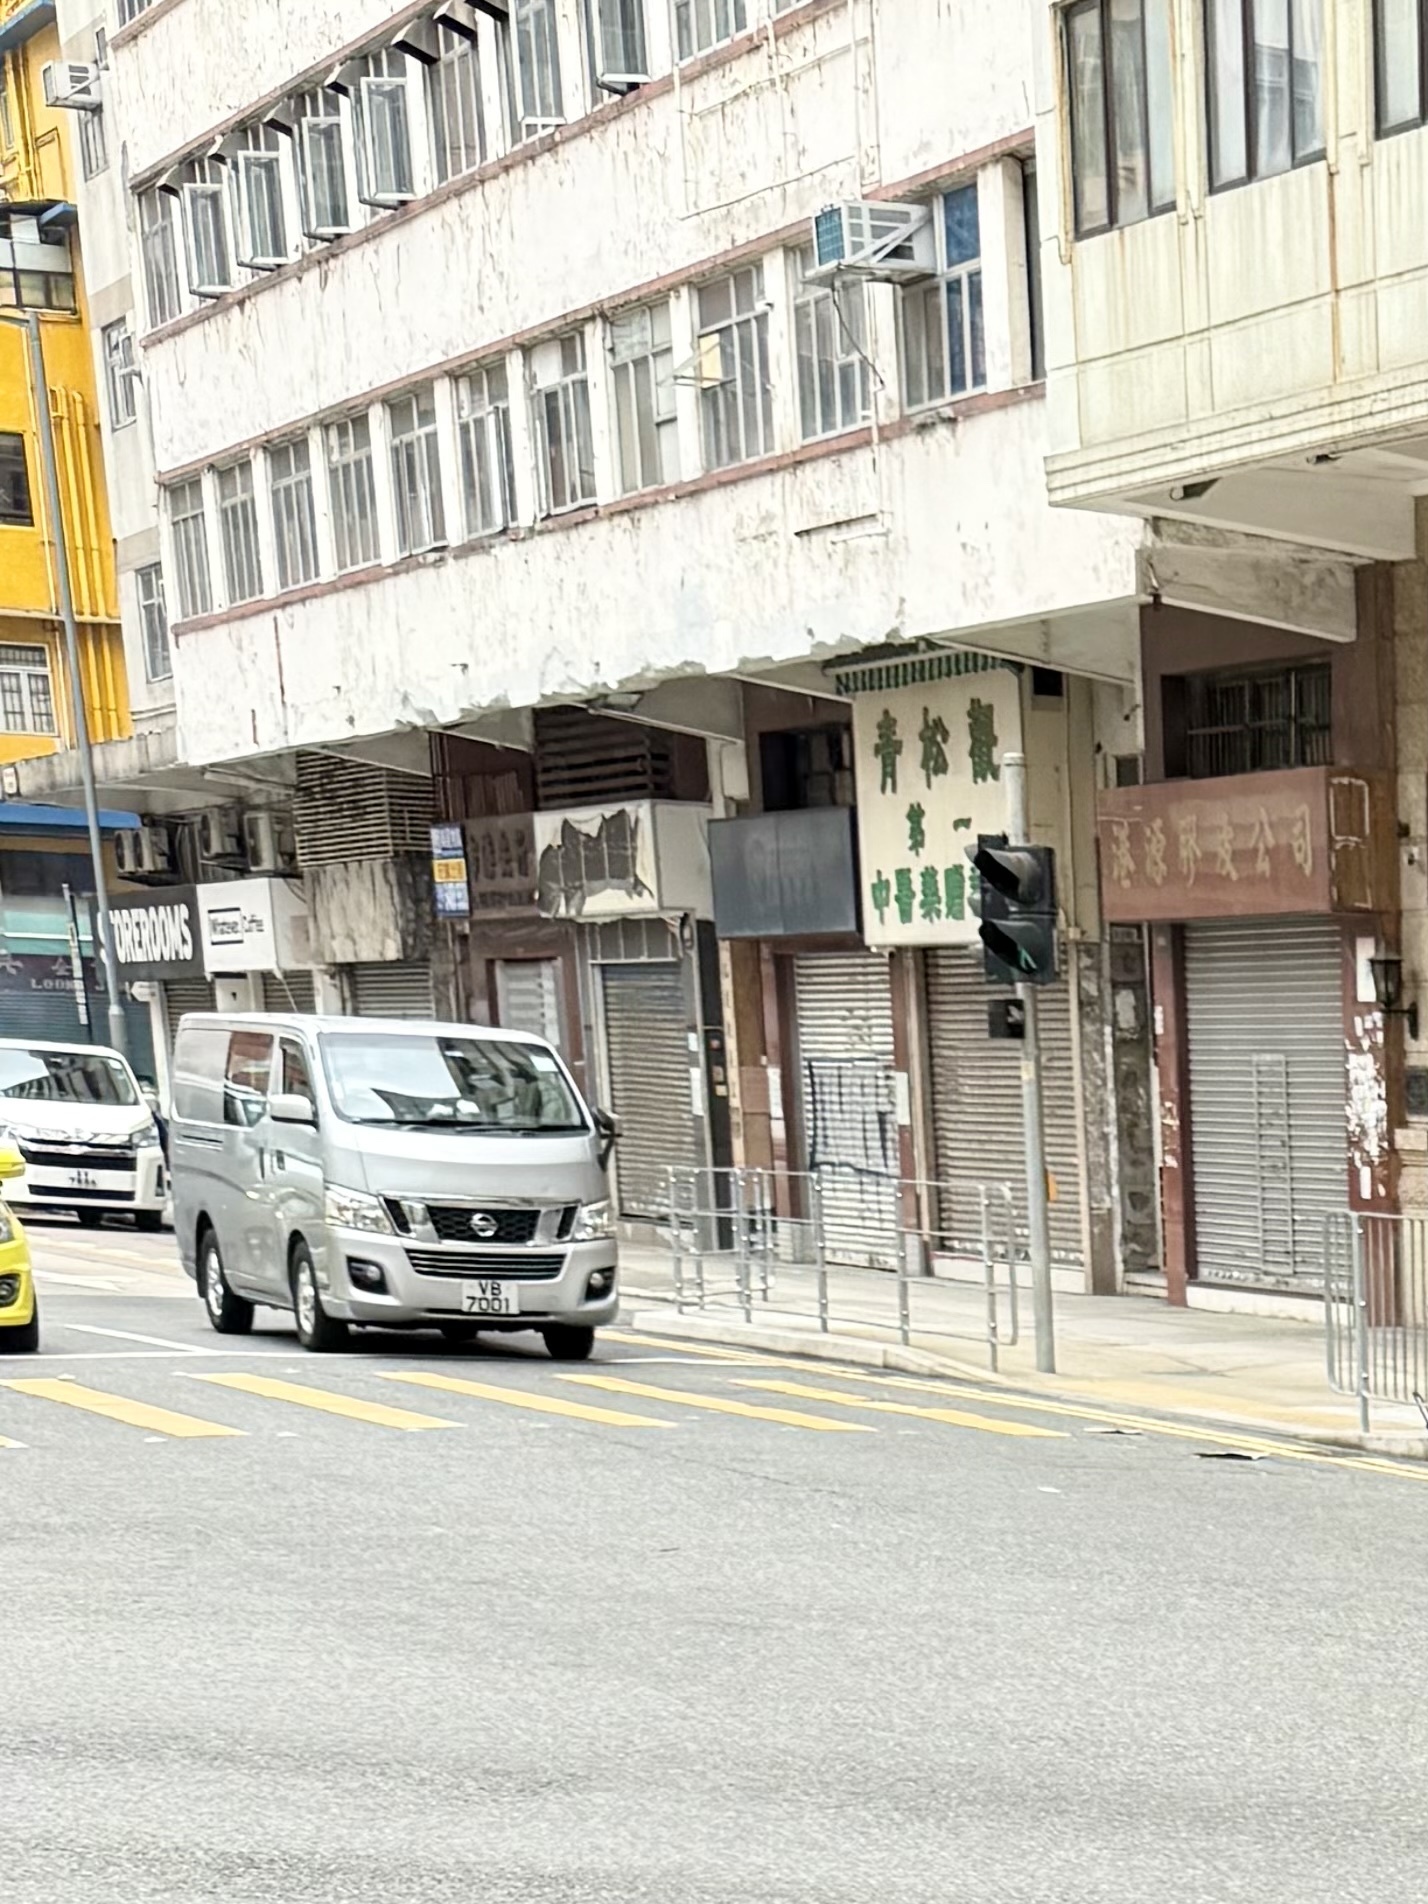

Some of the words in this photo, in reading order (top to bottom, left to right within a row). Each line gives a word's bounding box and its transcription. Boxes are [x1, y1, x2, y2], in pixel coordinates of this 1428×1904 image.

[905, 802, 972, 857] 第一
[479, 1281, 502, 1297] VB
[466, 1296, 510, 1313] 7001
